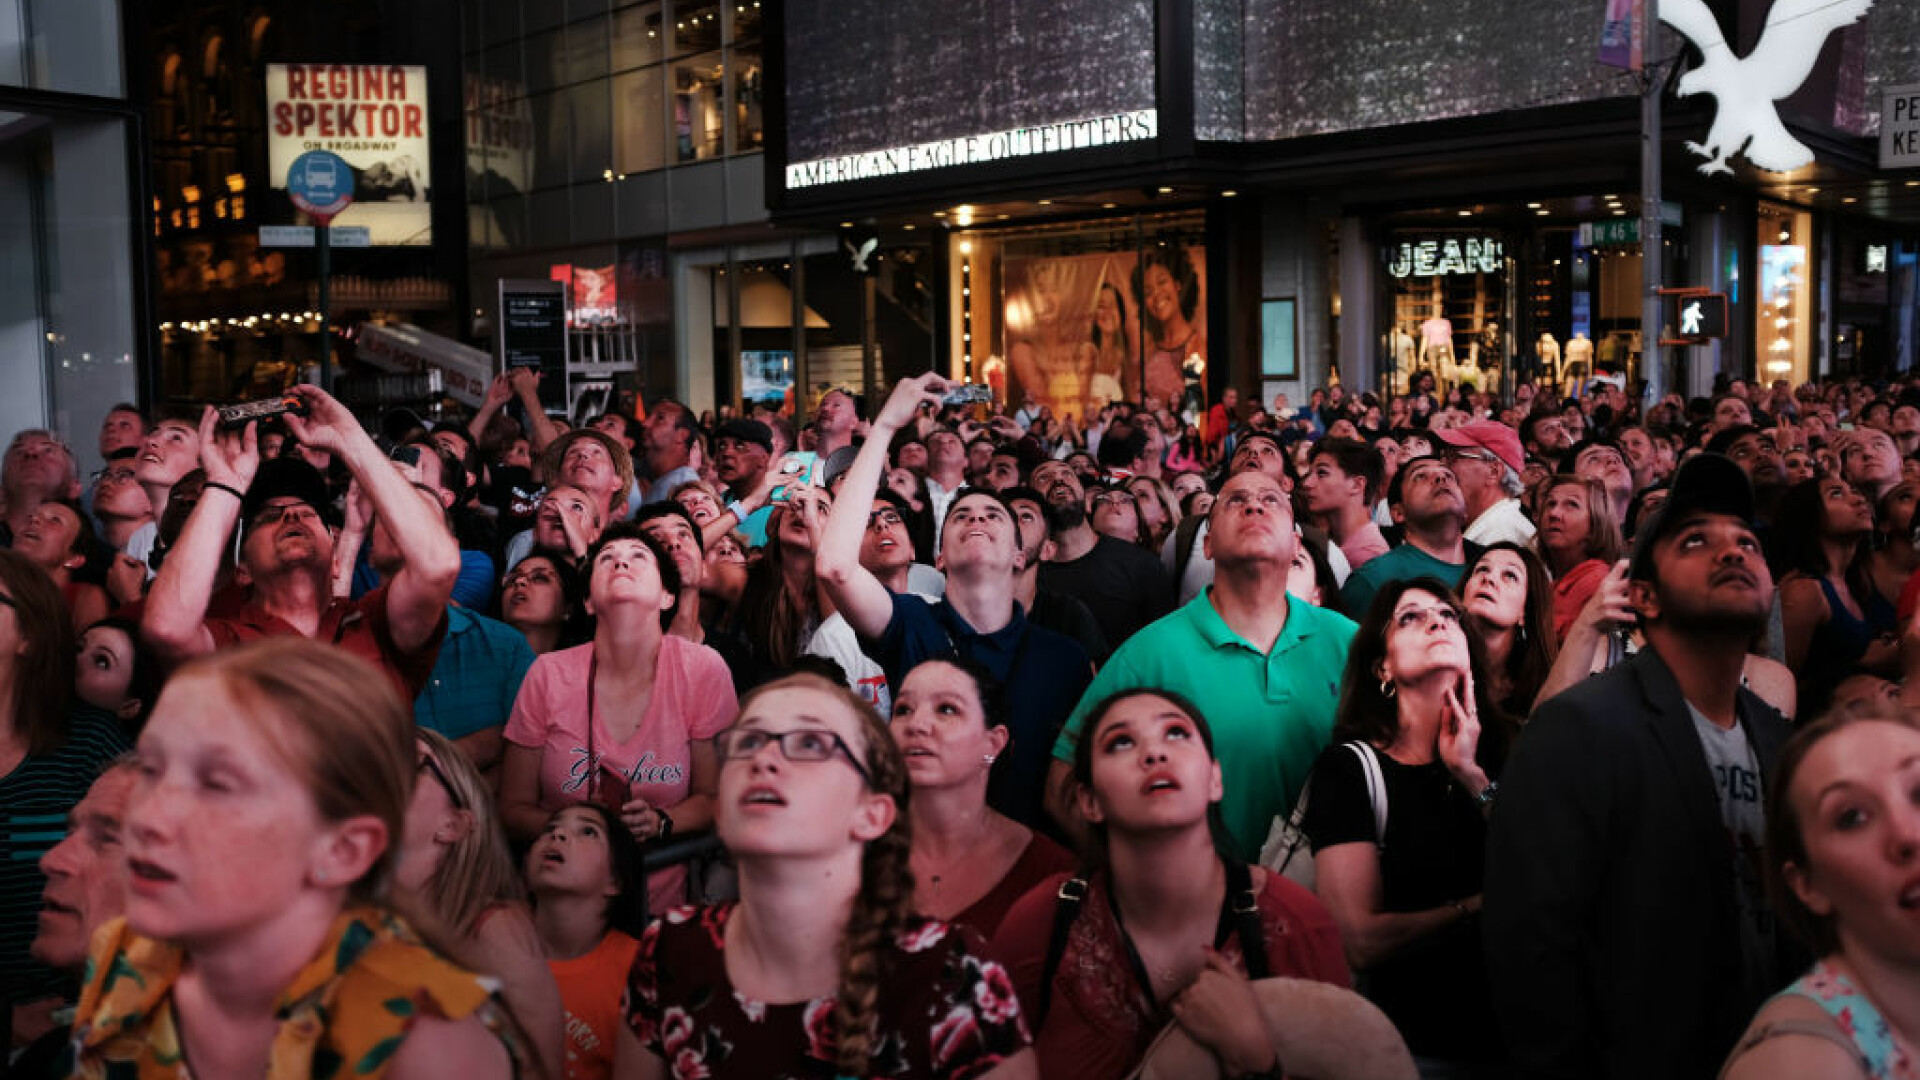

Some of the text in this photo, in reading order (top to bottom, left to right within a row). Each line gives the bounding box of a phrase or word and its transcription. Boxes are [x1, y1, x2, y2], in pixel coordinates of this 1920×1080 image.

[287, 64, 407, 100] REGINA
[274, 102, 423, 138] SPEKTOR
[303, 141, 398, 152] ON BROADWAY
[791, 111, 1151, 188] AMERICAN EAGLE OUTFITTERS
[1609, 222, 1626, 241] 46
